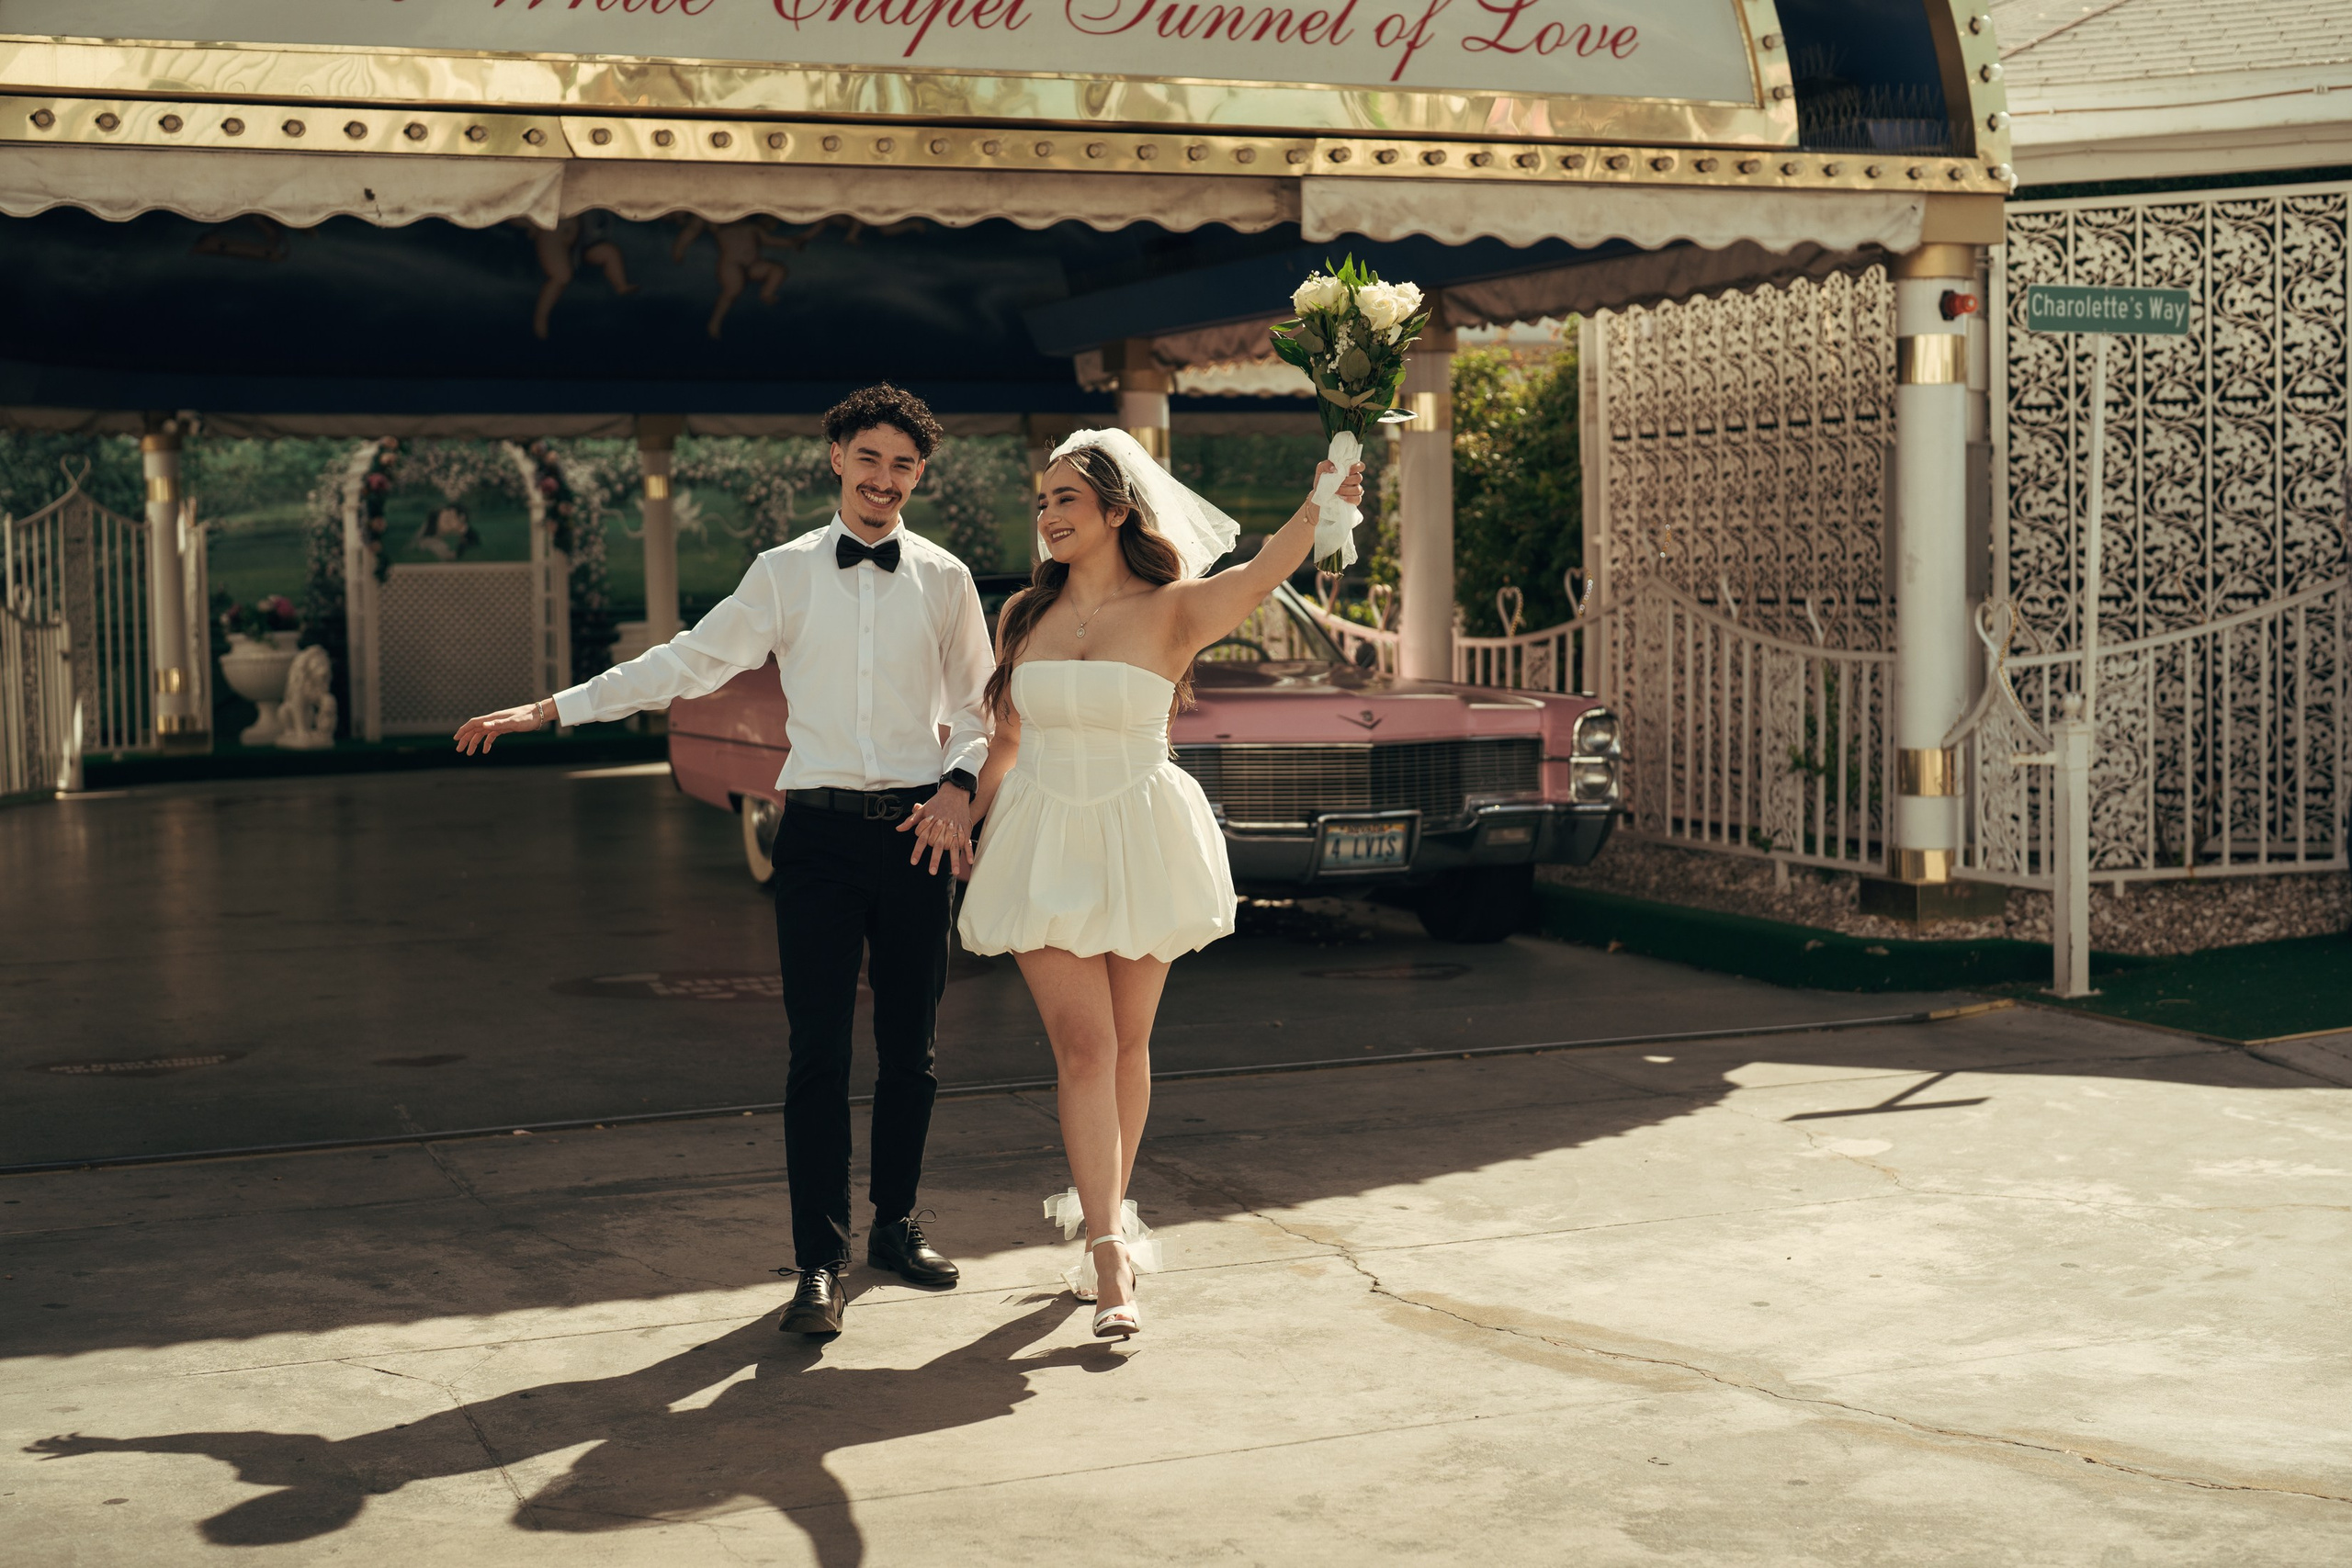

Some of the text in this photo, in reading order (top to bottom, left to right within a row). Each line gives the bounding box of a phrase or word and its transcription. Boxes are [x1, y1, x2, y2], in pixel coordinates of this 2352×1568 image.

[1374, 0, 1452, 82] of
[1461, 0, 1639, 59] Love
[2031, 292, 2187, 328] Charolette's Way
[1331, 835, 1397, 860] 4 LVIS
